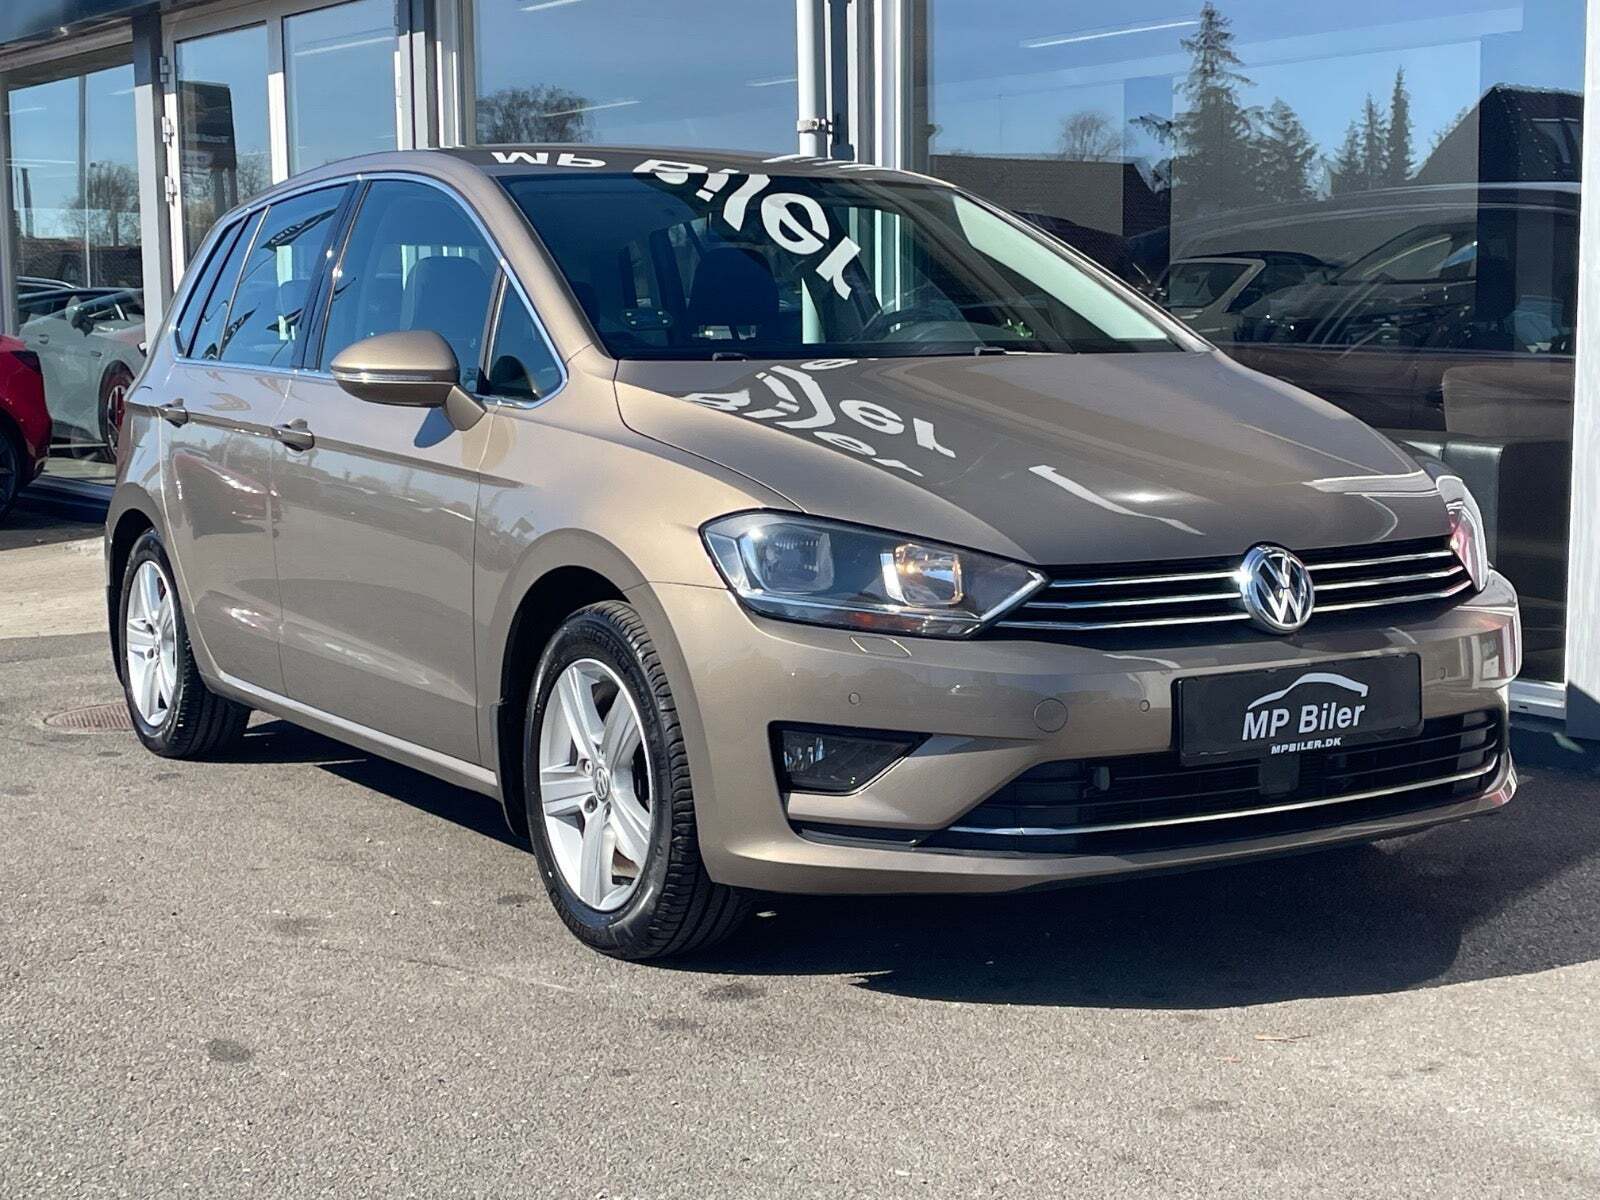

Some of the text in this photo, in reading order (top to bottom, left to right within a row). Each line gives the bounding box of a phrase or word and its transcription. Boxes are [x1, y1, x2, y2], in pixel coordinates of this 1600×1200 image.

[1242, 702, 1365, 741] MP Biler
[1270, 737, 1342, 755] MPBILER.DK
